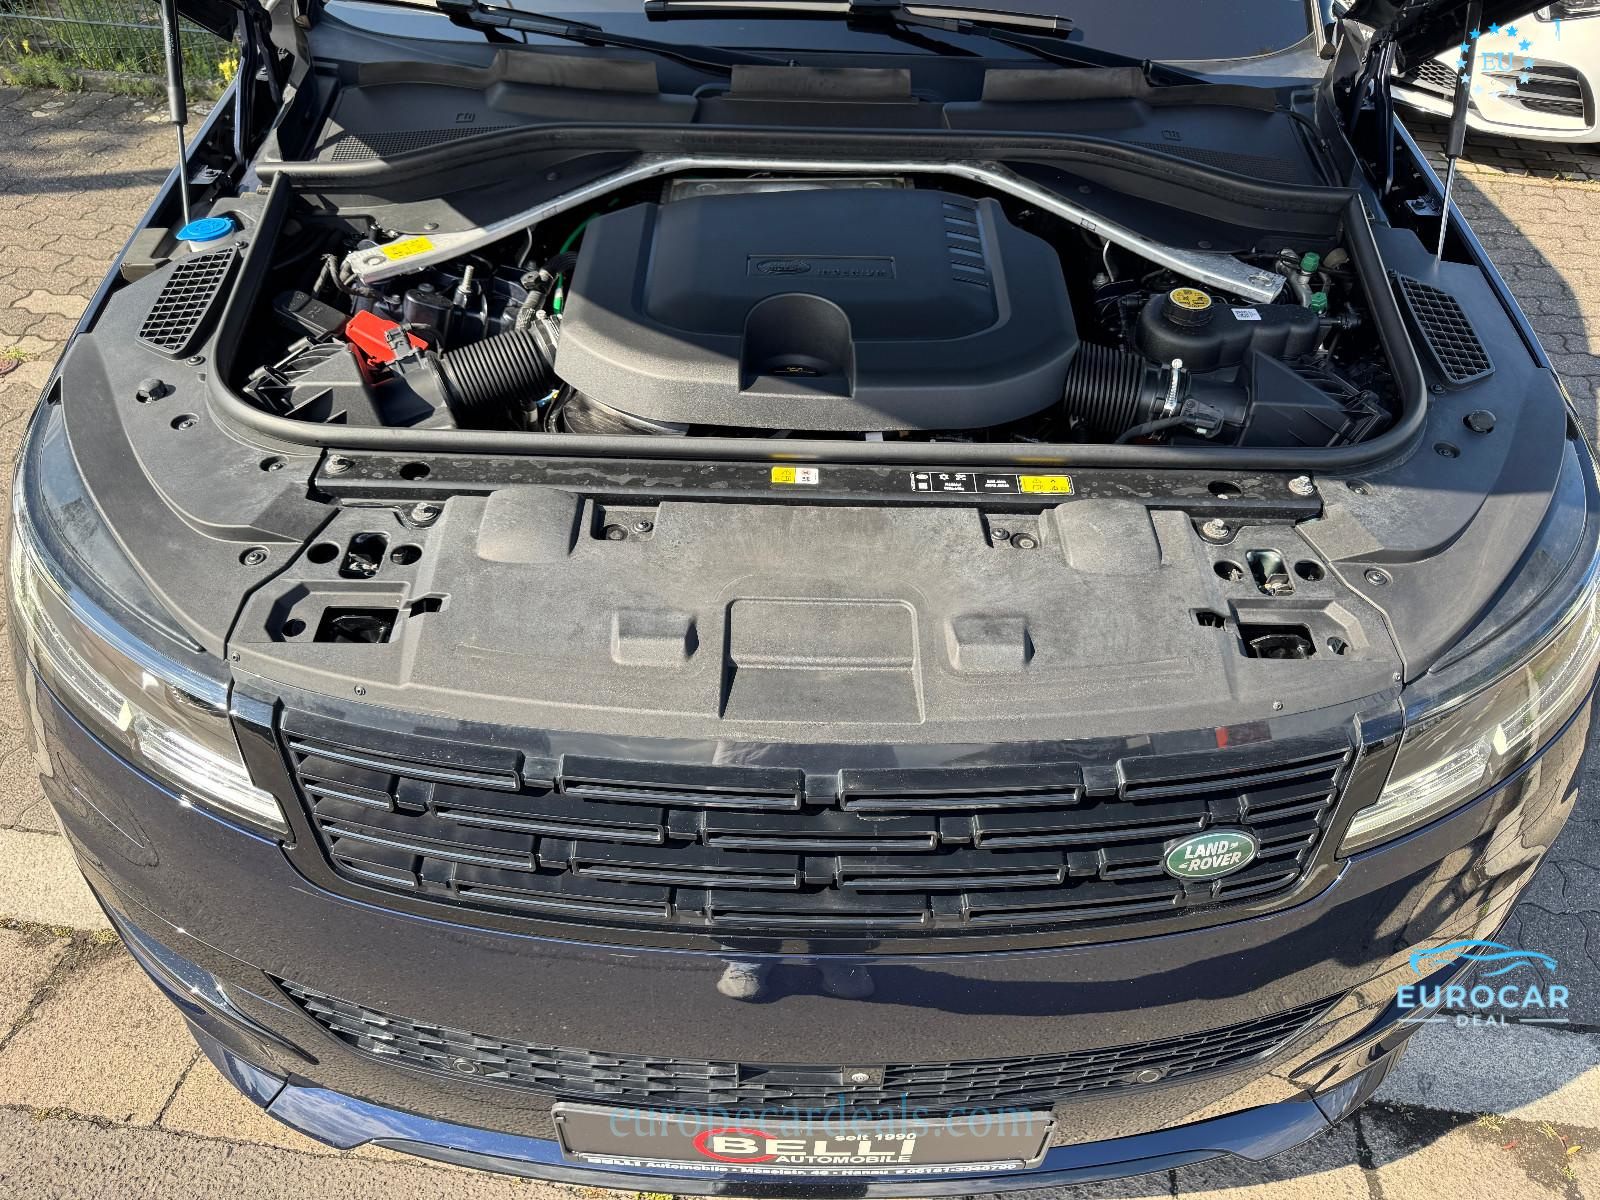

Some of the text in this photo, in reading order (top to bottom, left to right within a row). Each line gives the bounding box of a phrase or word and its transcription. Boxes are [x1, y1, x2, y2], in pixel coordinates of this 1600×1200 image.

[1184, 840, 1229, 859] LAND
[1187, 851, 1242, 871] ROVER
[713, 1136, 916, 1155] BELLI
[834, 1133, 917, 1142] seit 1990
[588, 1157, 641, 1167] BELLI
[646, 1162, 728, 1172] Automobile
[775, 1154, 913, 1164] AUTOMOBILE
